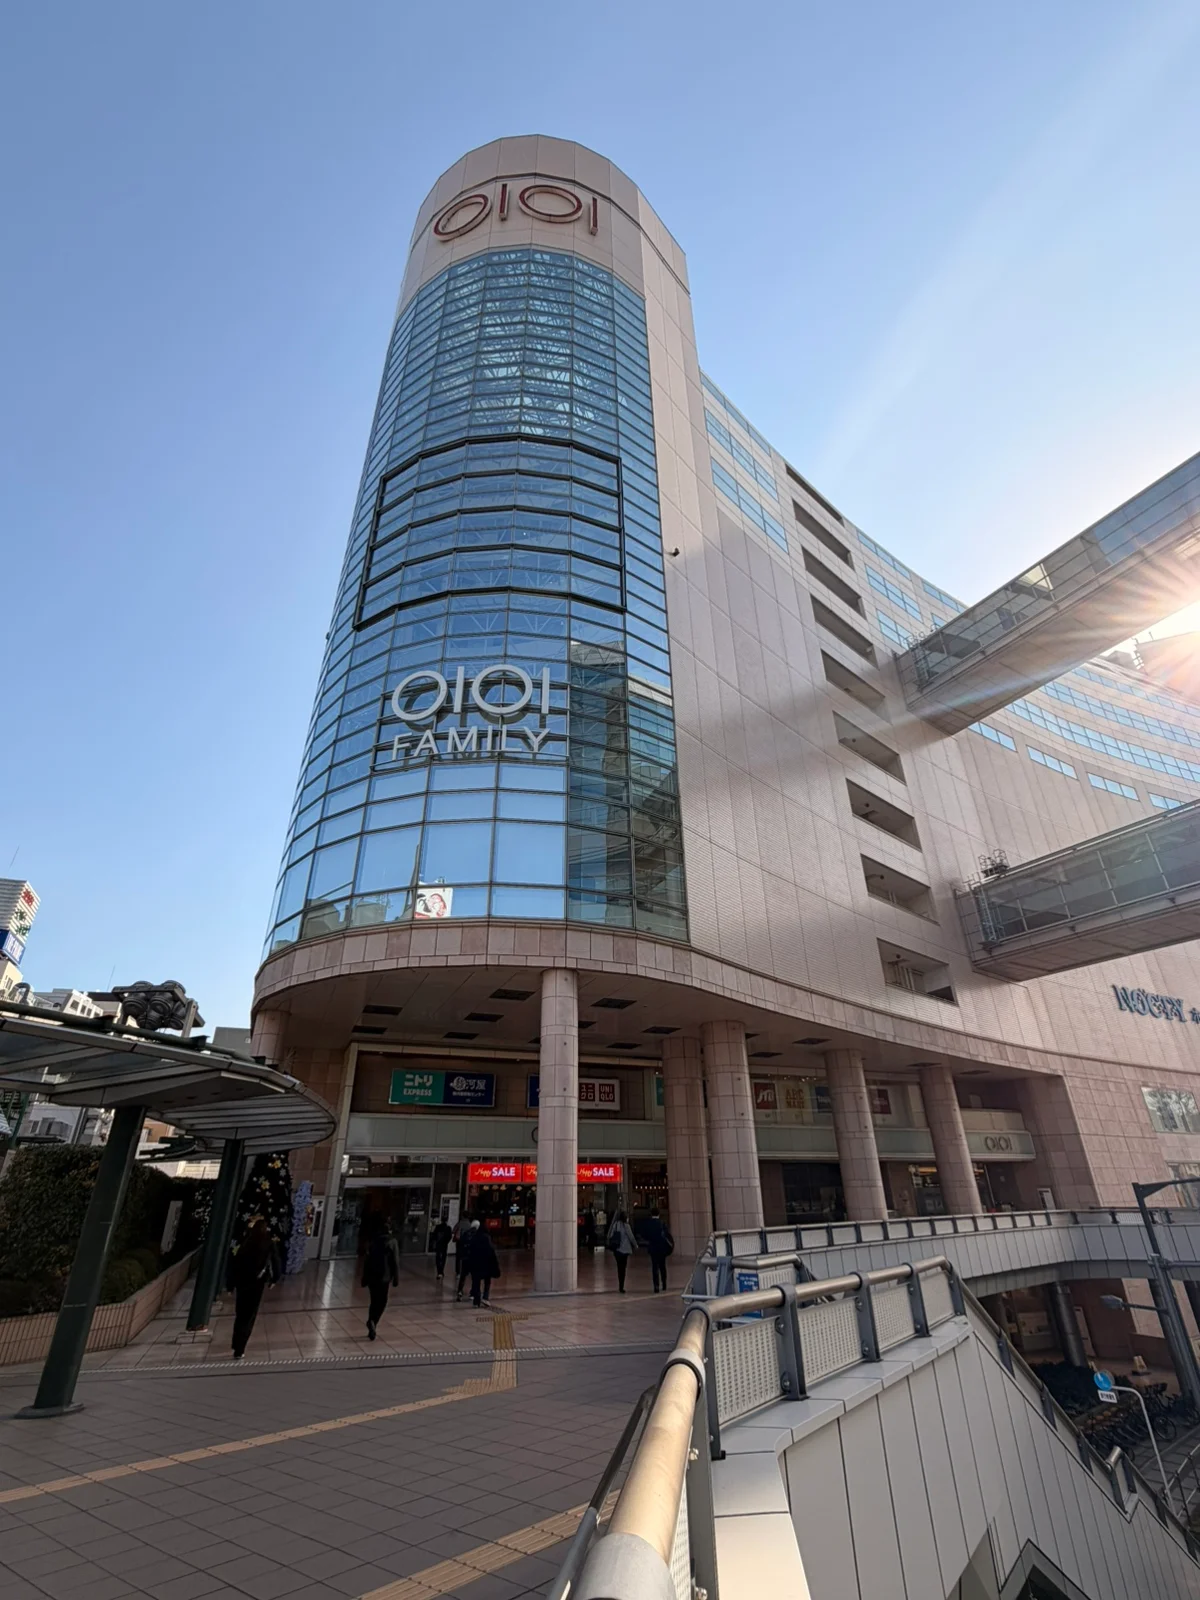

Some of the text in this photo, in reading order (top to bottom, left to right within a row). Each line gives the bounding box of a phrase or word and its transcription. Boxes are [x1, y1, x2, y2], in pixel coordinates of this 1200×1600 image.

[391, 726, 551, 761] FAMILY
[404, 1074, 433, 1087] ニトリ
[403, 1088, 432, 1096] EXPRESS
[600, 1093, 613, 1101] QLO
[492, 1167, 516, 1176] SALE
[592, 1167, 615, 1176] SALE
